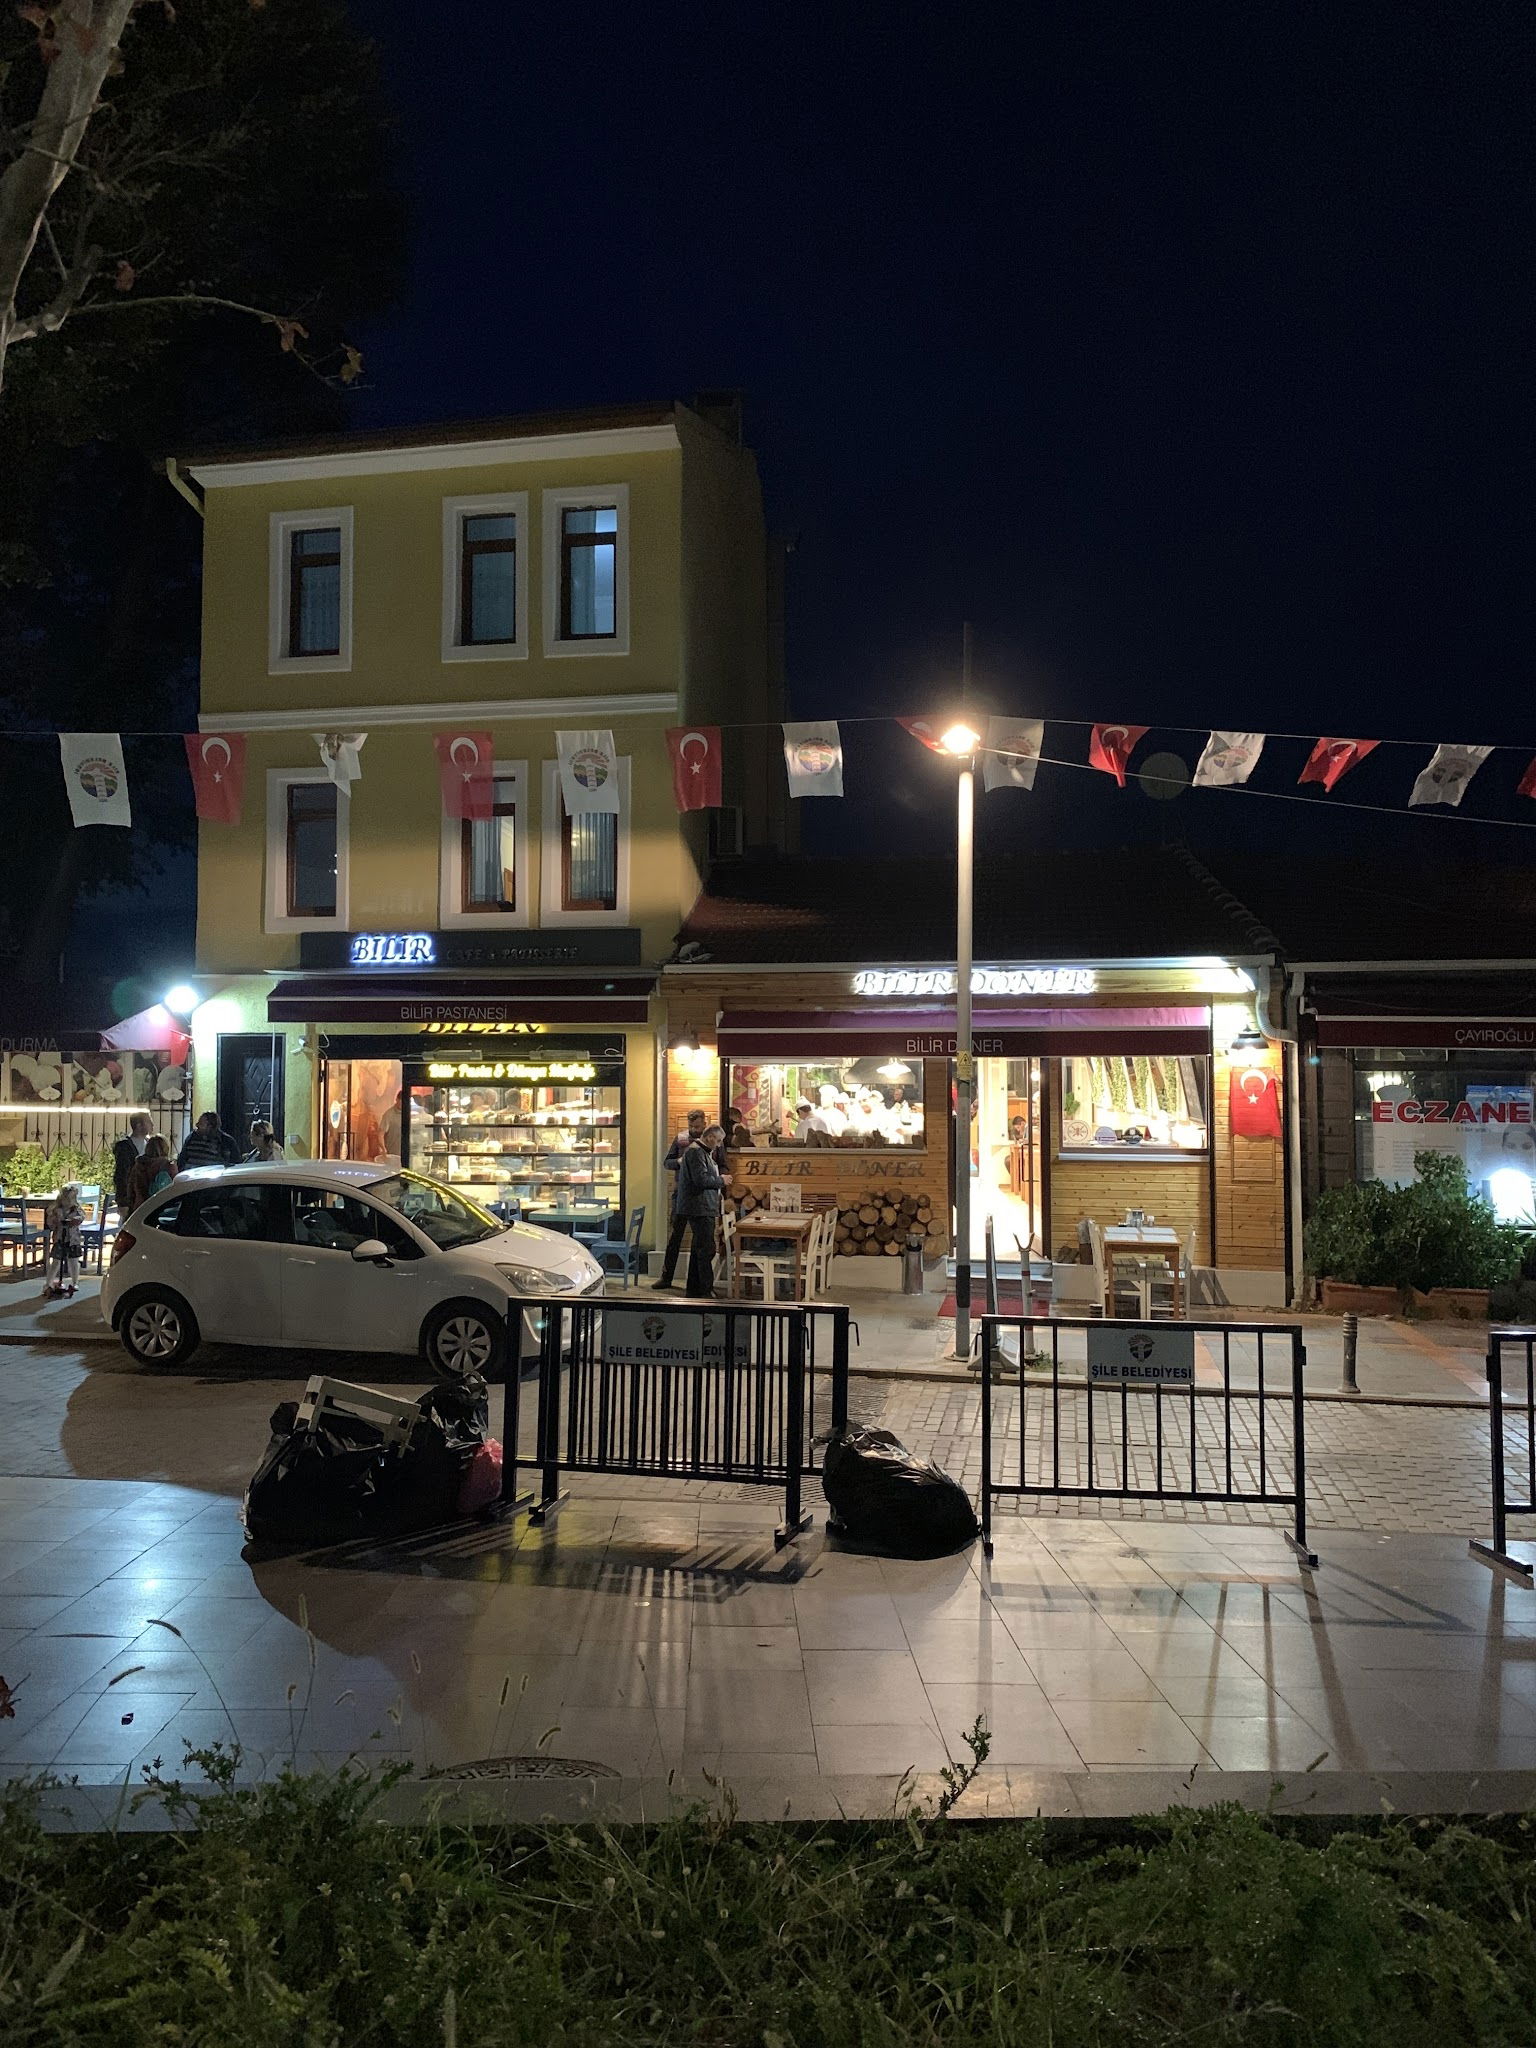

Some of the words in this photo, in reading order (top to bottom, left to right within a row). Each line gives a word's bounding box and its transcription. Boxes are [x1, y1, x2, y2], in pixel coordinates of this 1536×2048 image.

[352, 932, 433, 961] BİLİR
[400, 1003, 433, 1019] BİLİR
[436, 1004, 508, 1020] PASTANESİ
[1454, 1027, 1534, 1044] ÇAYIROĞLU
[906, 1036, 943, 1053] BİLİR
[947, 1039, 1004, 1053] DNER
[1371, 1101, 1533, 1124] ECZANE
[608, 1344, 633, 1358] ŞİLE
[635, 1346, 699, 1361] BELEDİYESİ
[1091, 1363, 1118, 1379] ŞİLE
[1121, 1364, 1192, 1379] BELEDİYESİ
